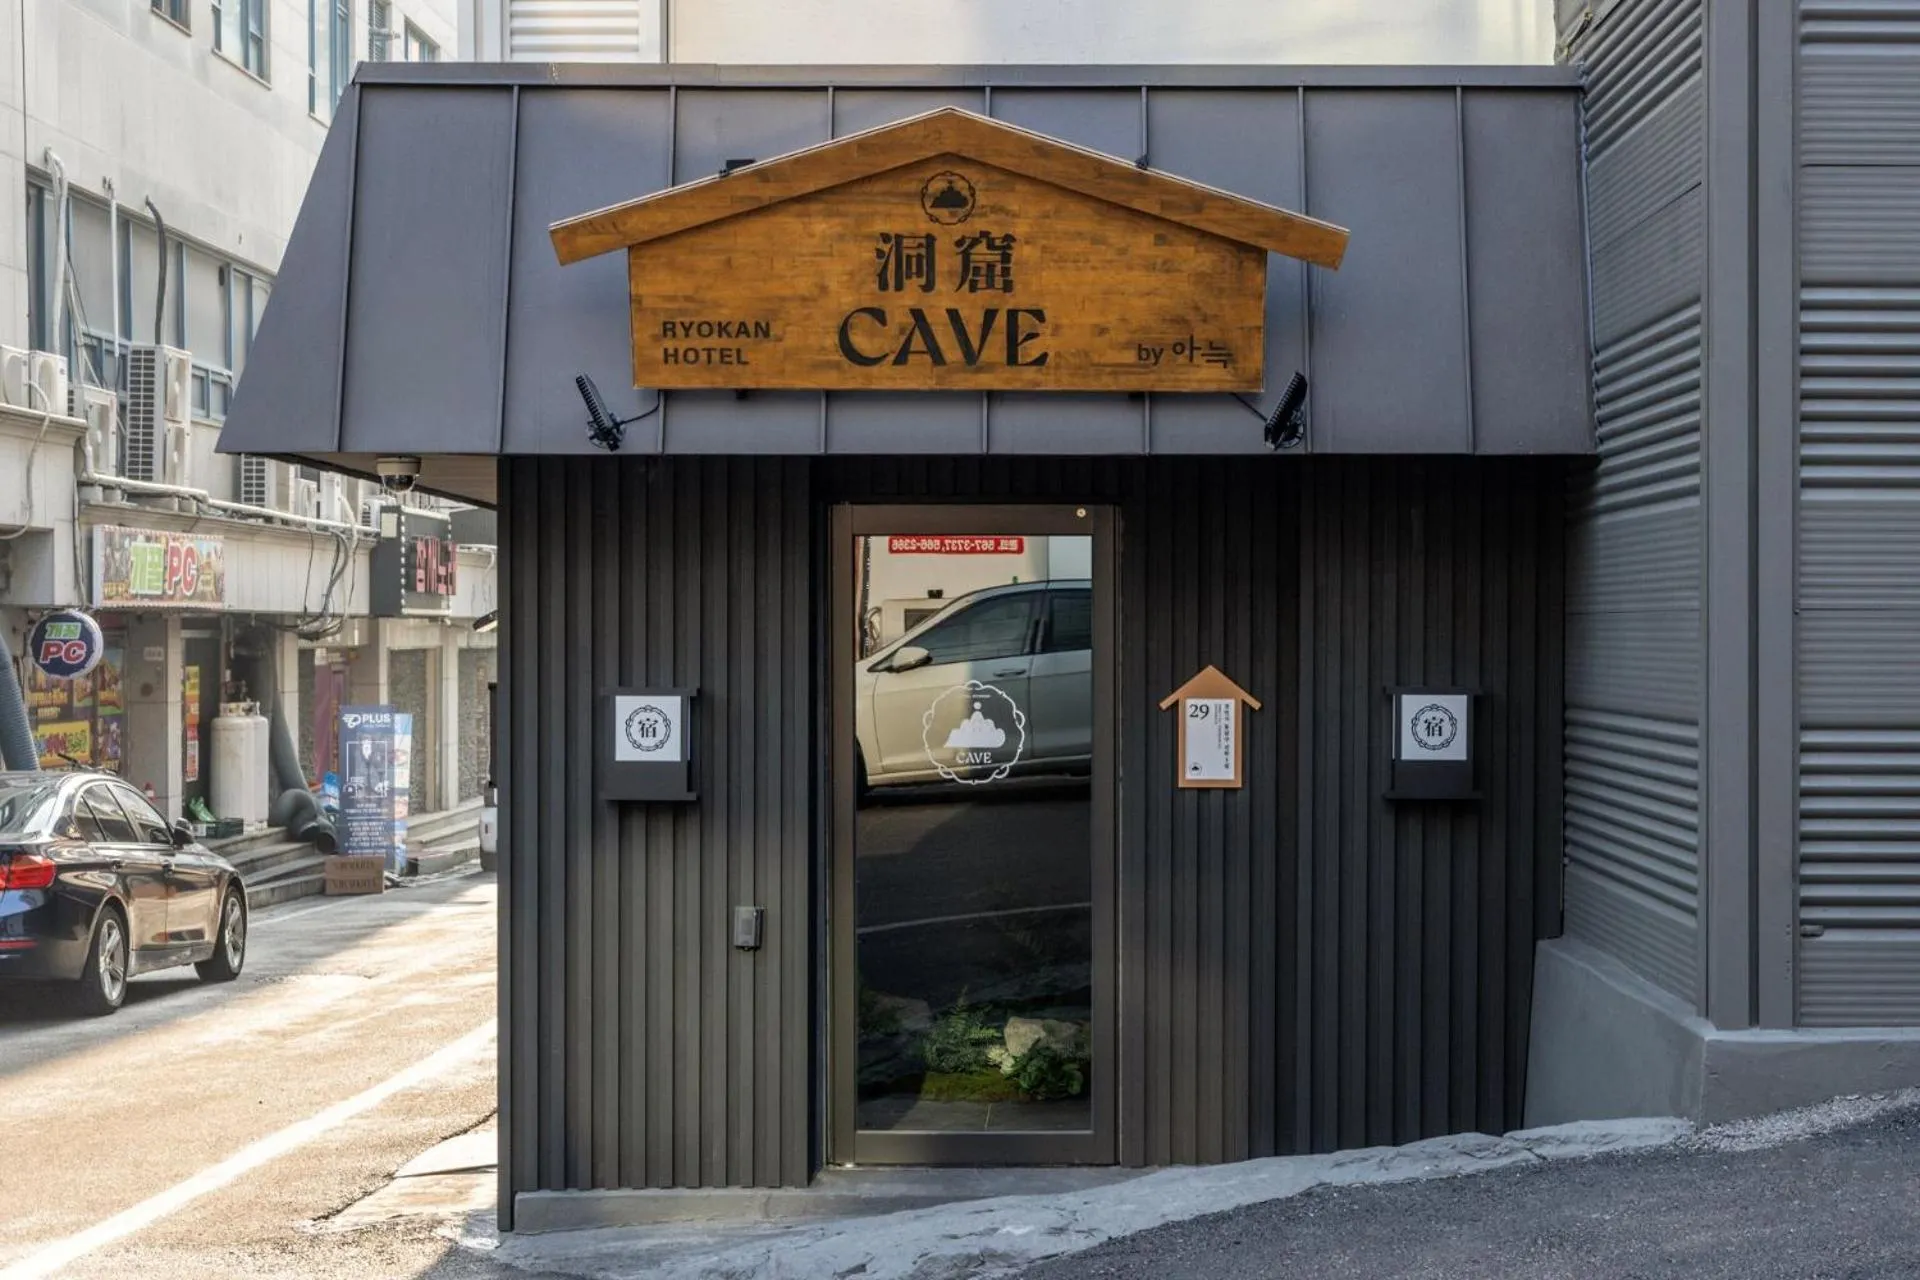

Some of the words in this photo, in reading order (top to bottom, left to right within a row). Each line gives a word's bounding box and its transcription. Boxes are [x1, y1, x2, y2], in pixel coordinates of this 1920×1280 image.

[874, 229, 1018, 294] 洞窟
[662, 319, 772, 340] RYOKAN
[837, 306, 1050, 368] CAVE
[662, 346, 751, 366] HOTEL
[1137, 342, 1164, 366] by
[1172, 334, 1235, 369] 아늑
[40, 640, 87, 664] PC
[362, 713, 392, 724] PLUS
[1188, 703, 1210, 720] 29
[955, 750, 993, 765] CAVE
